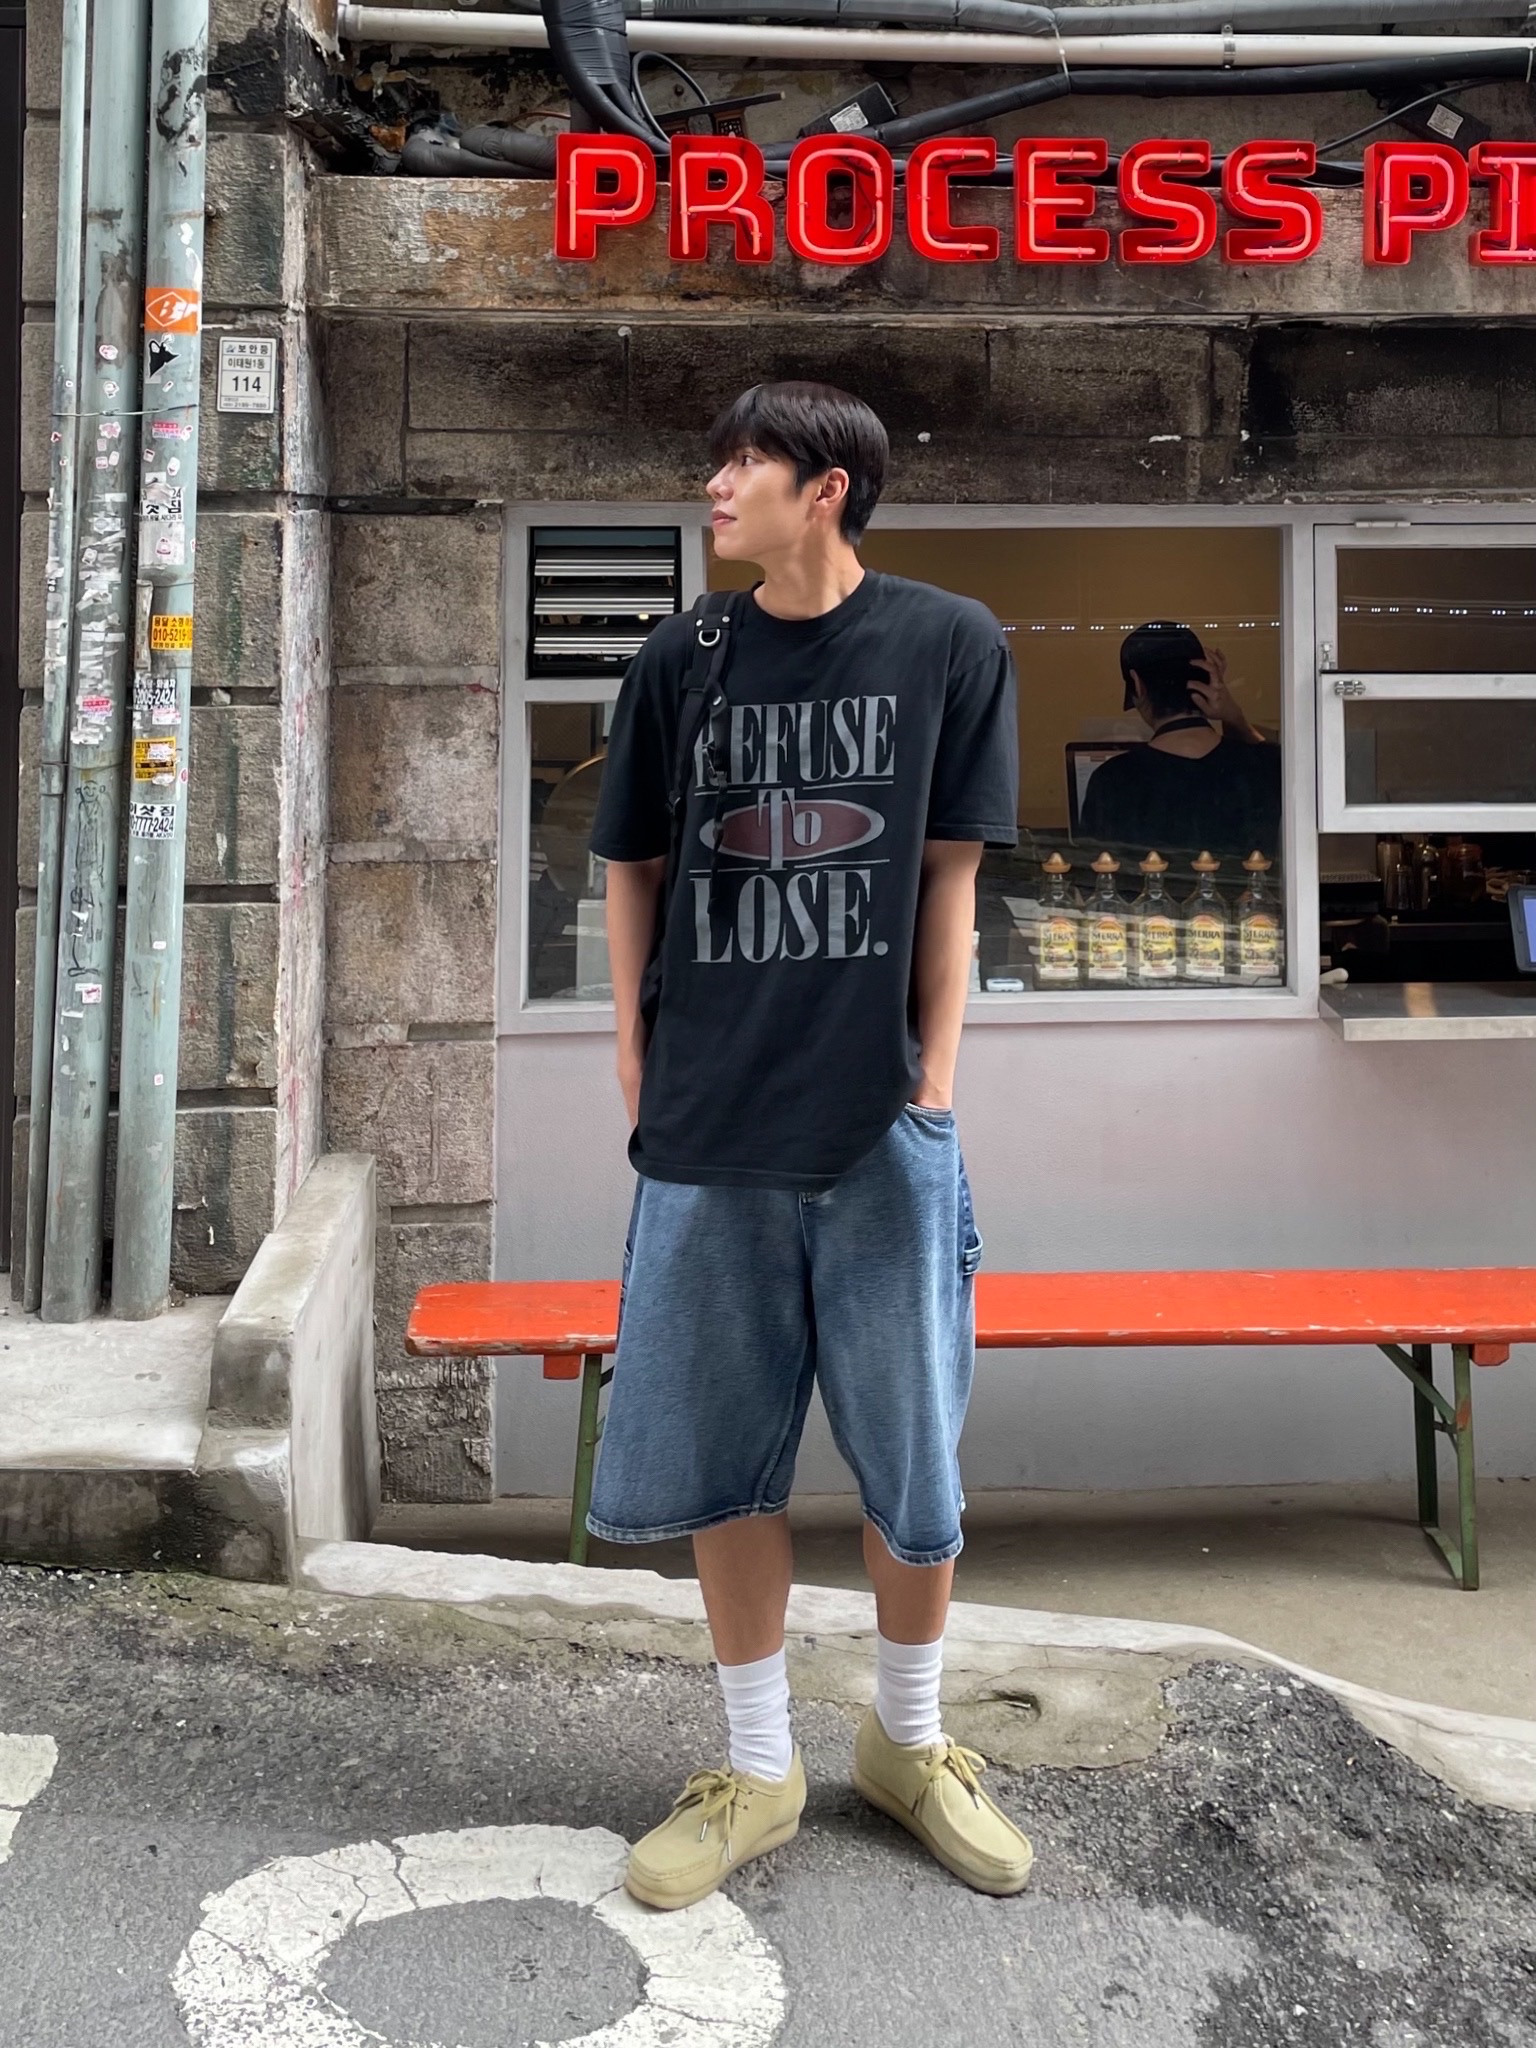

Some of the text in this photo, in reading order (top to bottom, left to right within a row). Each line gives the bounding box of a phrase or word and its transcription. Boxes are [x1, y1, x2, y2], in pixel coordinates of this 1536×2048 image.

[555, 132, 1323, 265] PROCESS
[232, 376, 261, 392] 114
[758, 788, 822, 871] To
[1092, 930, 1124, 941] SIERRA
[1188, 928, 1221, 940] SIERRA
